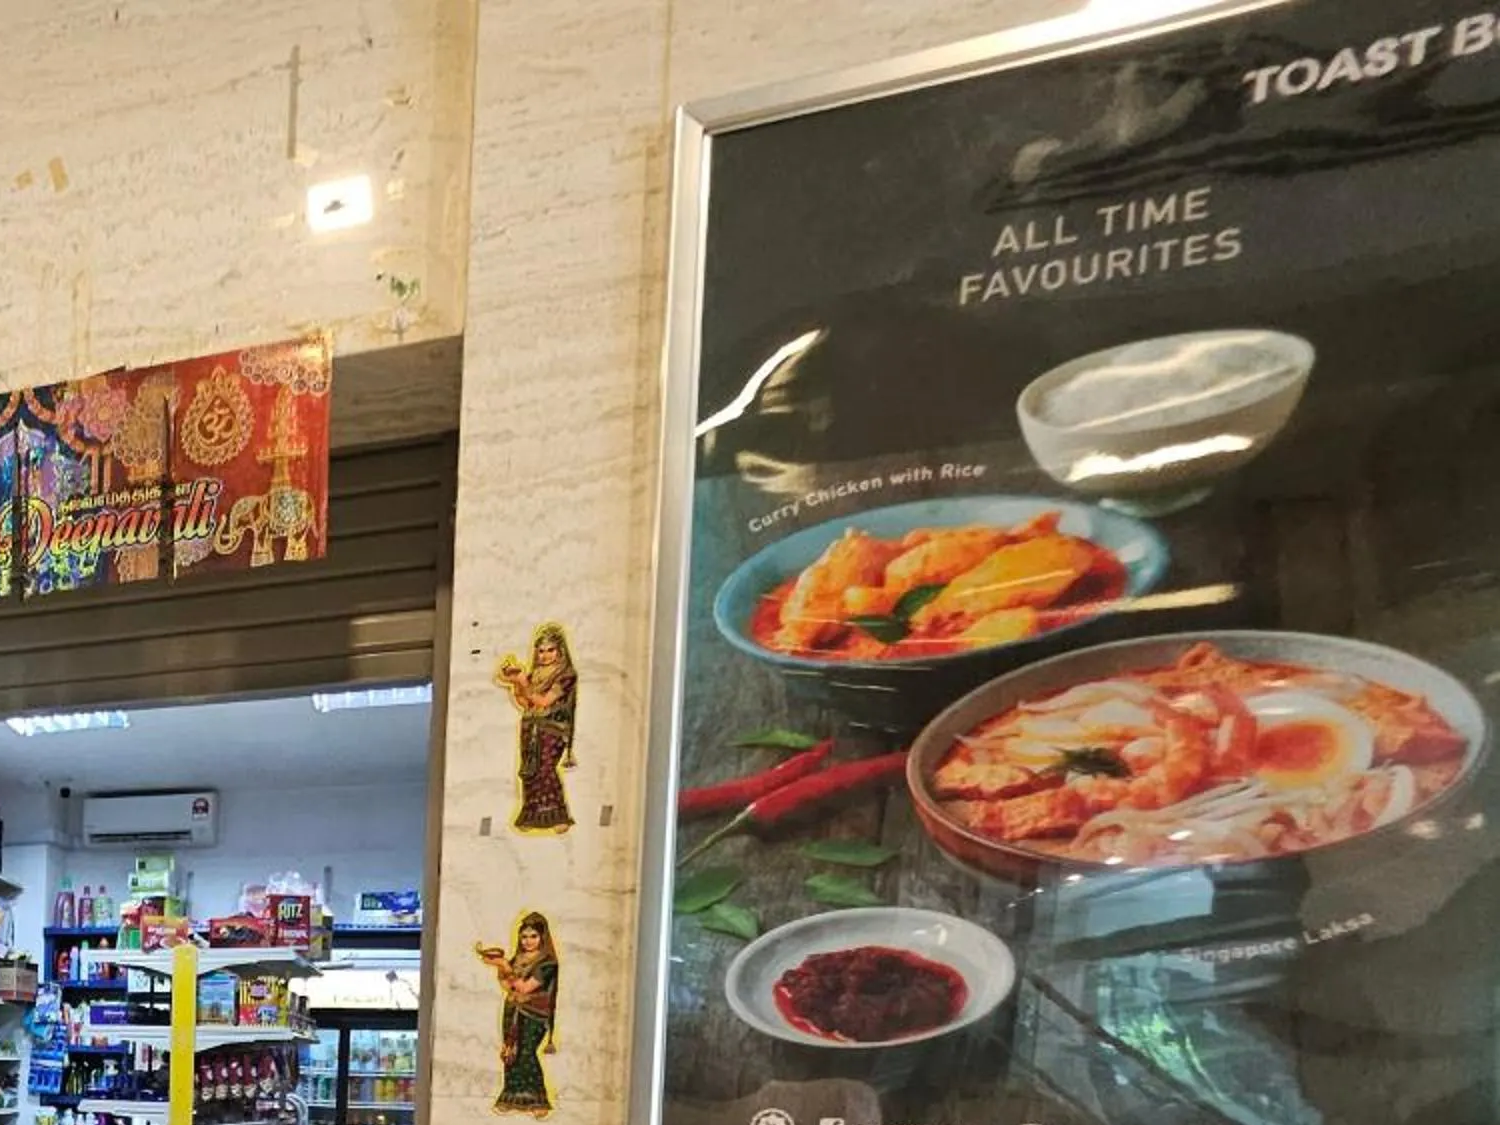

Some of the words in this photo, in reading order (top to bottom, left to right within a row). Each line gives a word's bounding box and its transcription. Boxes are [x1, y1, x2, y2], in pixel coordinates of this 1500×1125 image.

[1242, 23, 1444, 103] TOAST
[1451, 12, 1500, 57] B
[991, 215, 1079, 258] ALL
[1096, 186, 1212, 236] TIME
[959, 227, 1242, 306] FAVOURITES
[748, 499, 801, 533] Curry
[805, 476, 883, 507] Chicken
[889, 467, 933, 486] with
[940, 462, 987, 480] Rice
[278, 902, 303, 920] RITZ
[1181, 937, 1298, 964] Singapore
[1302, 912, 1376, 945] Laksa
